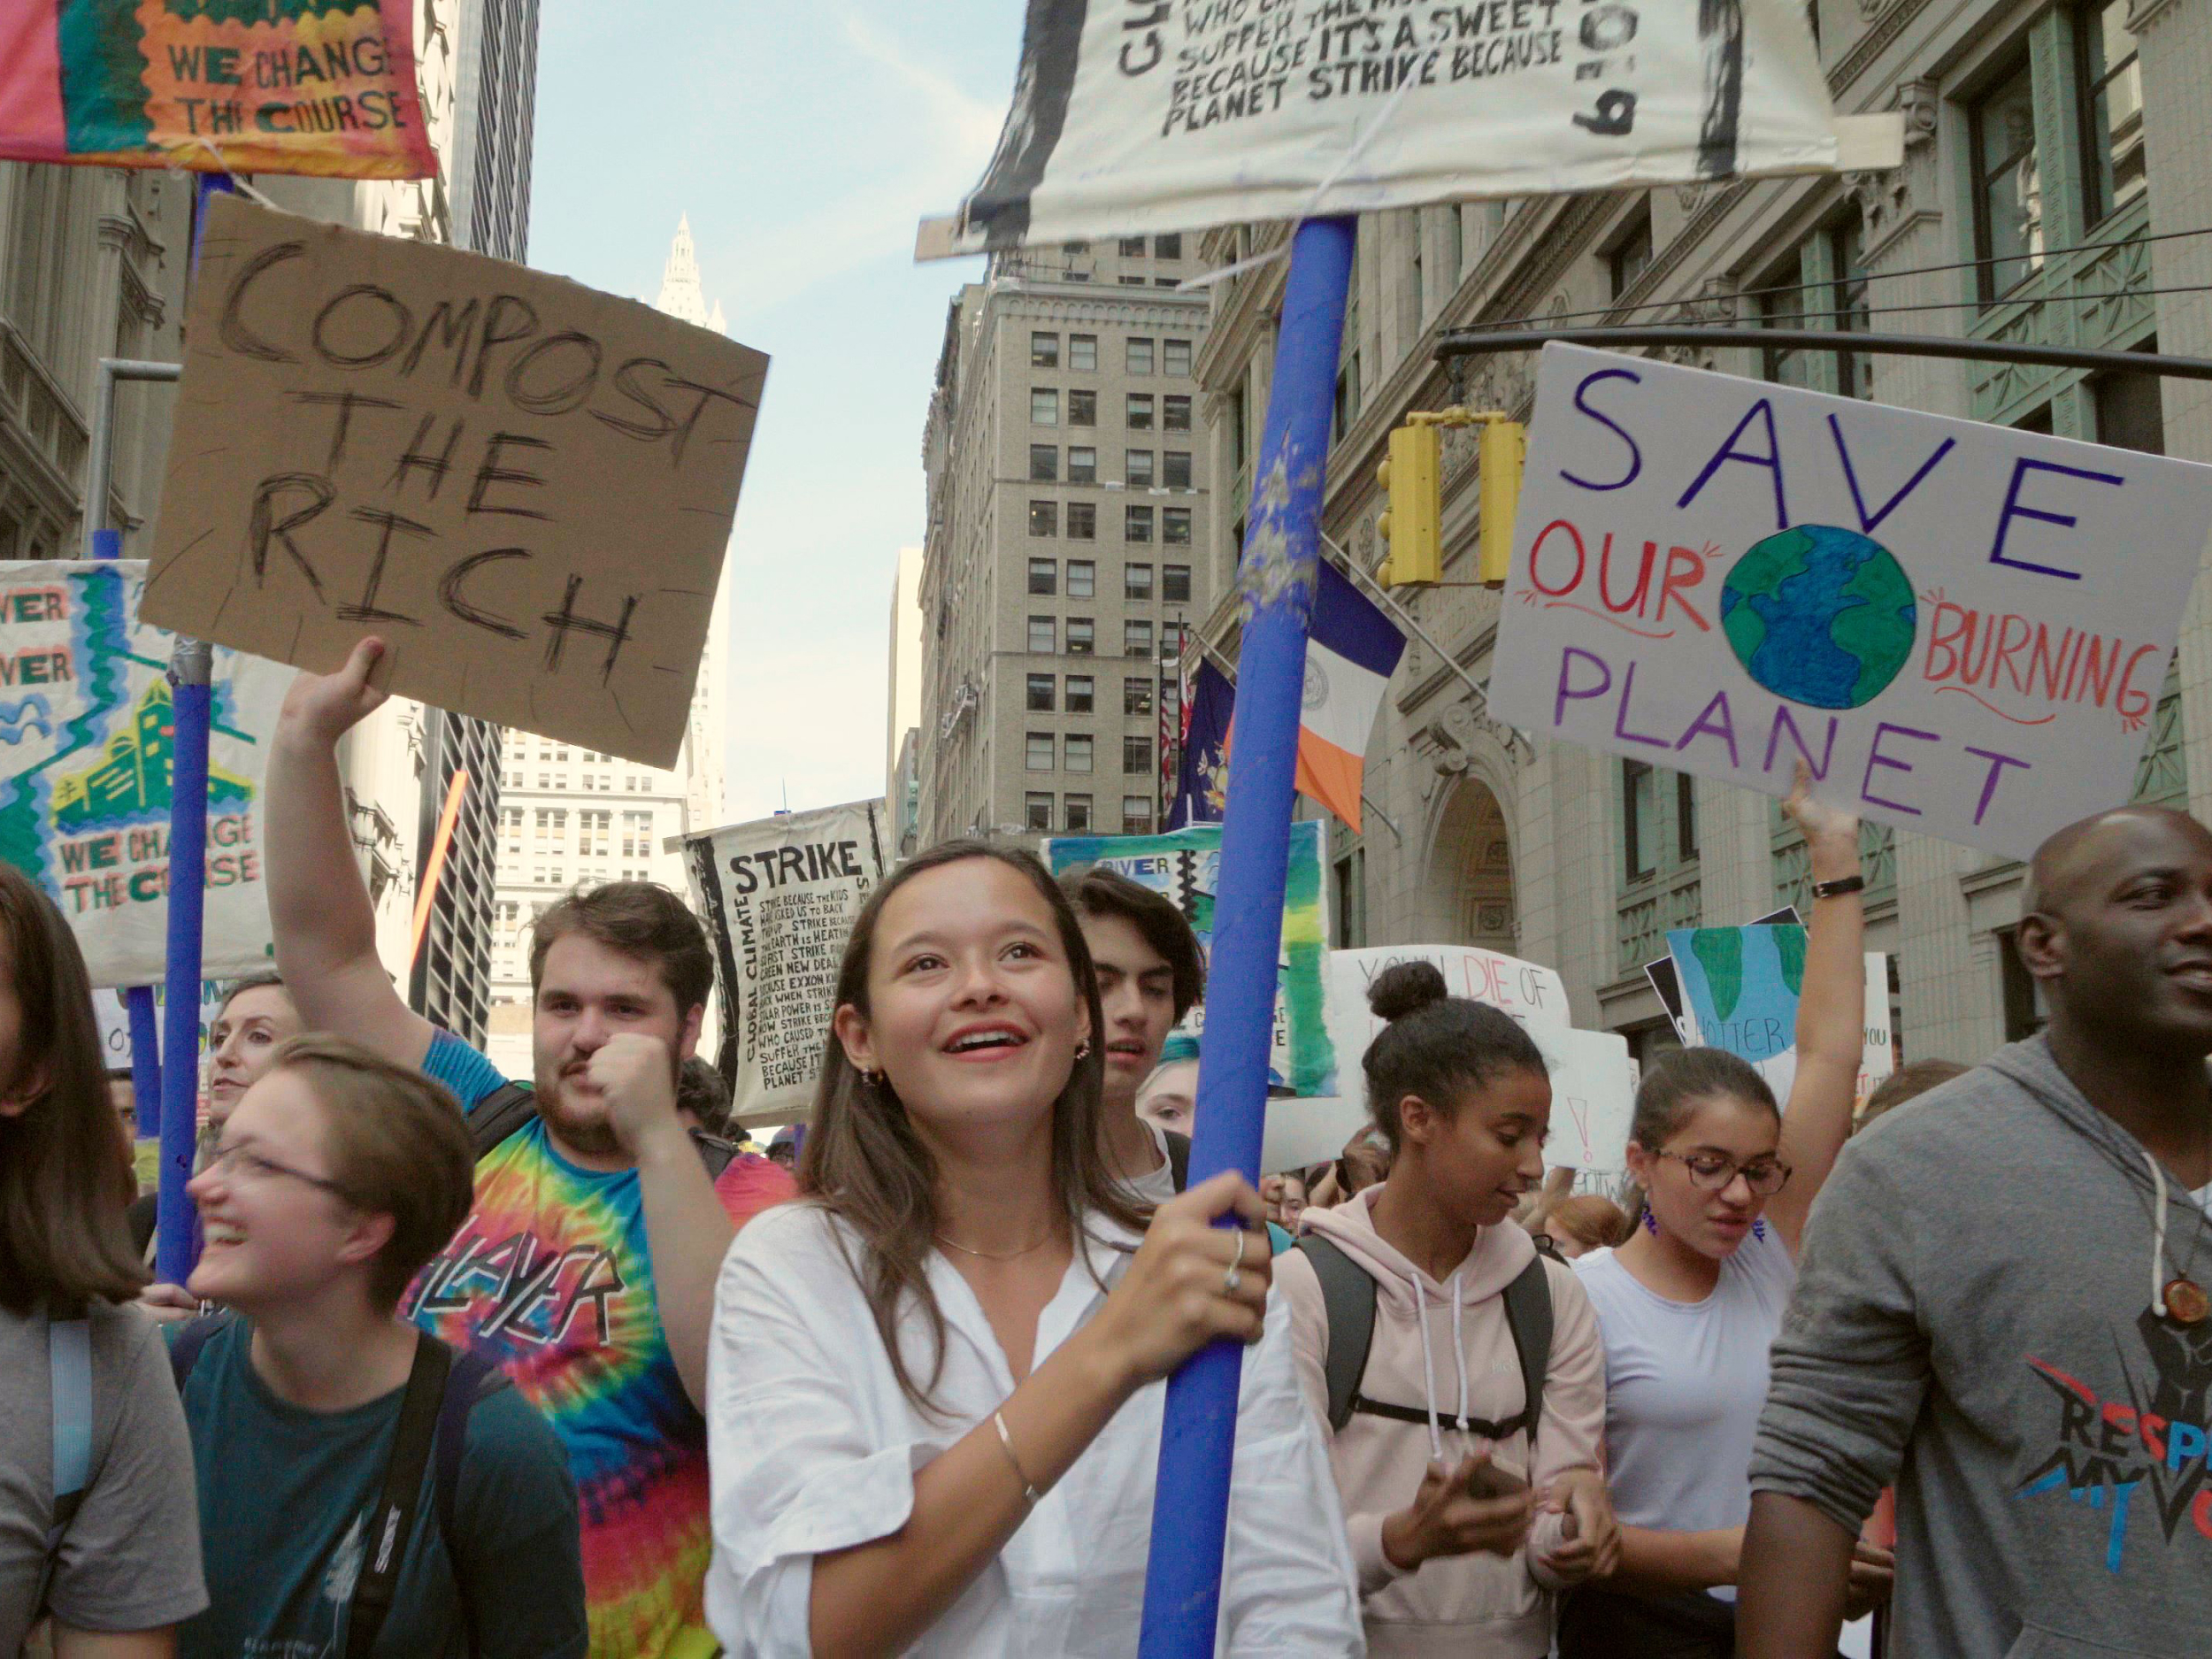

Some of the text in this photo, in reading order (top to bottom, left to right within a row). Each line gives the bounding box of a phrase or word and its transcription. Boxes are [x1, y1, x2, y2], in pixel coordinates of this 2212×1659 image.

[1172, 38, 1309, 106] BECAUSE
[1393, 15, 1417, 50] A
[1429, 0, 1562, 42] SWEET
[1178, 11, 1294, 73] SUFFER
[168, 44, 242, 85] WE
[1161, 29, 1563, 137] PLANET STRIKE BECAUSE
[255, 90, 408, 134] COURSE
[220, 239, 760, 469] COMPOST
[283, 389, 557, 525] THE
[1559, 368, 2124, 580] SAVE
[250, 471, 644, 688] RICH
[1529, 518, 1710, 632] OUR
[1923, 600, 2159, 718] BURNING
[1554, 647, 2032, 826] PLANET
[58, 817, 250, 874] WE CHGE
[730, 841, 863, 895] STRIKE
[64, 876, 125, 914] THE
[783, 892, 815, 906] BECAUSE
[829, 889, 849, 902] KIDS
[796, 906, 807, 918] US
[810, 907, 821, 916] TO
[823, 902, 844, 915] BACK
[734, 895, 757, 980] CLIMATE
[772, 933, 799, 949] EARTH
[802, 936, 811, 945] IS
[792, 918, 828, 932] STRIKE
[787, 960, 810, 975] NEW
[791, 943, 827, 960] STRIKE
[775, 991, 803, 1003] WHEN
[789, 974, 824, 989] EXXON
[1463, 955, 1512, 1007] DIE
[1519, 966, 1547, 1010] OF
[780, 1015, 811, 1030] STRIKE
[781, 1002, 811, 1018] POWER
[758, 1033, 780, 1048] WHO
[784, 1027, 814, 1044] CAUSED
[759, 1044, 799, 1064] SUFFER
[762, 1057, 807, 1078] BECAUSE
[764, 1071, 804, 1090] PLANET
